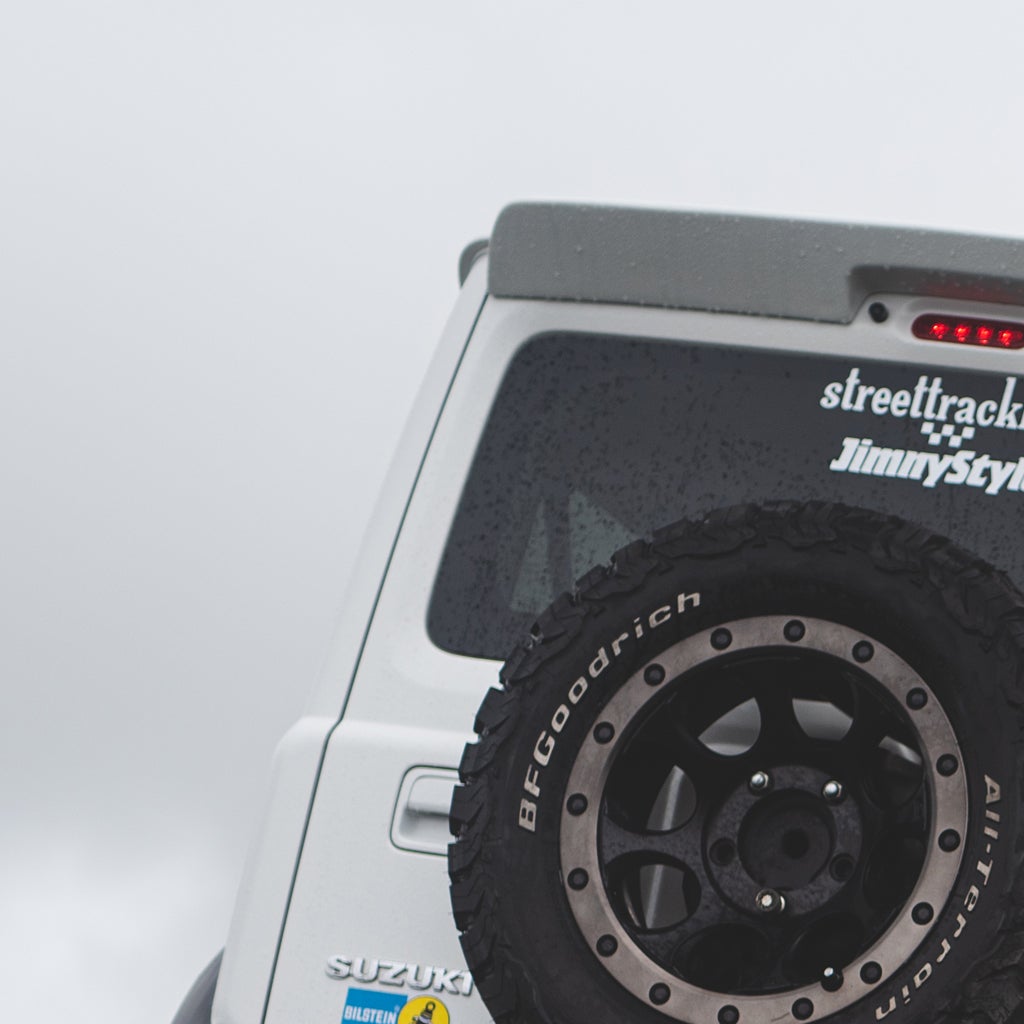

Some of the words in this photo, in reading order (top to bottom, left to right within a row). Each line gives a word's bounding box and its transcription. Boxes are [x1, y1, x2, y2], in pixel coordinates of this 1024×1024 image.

[518, 592, 700, 832] BFGoodrich
[325, 954, 474, 996] SUZUKI
[875, 774, 1000, 1020] All-Terrain
